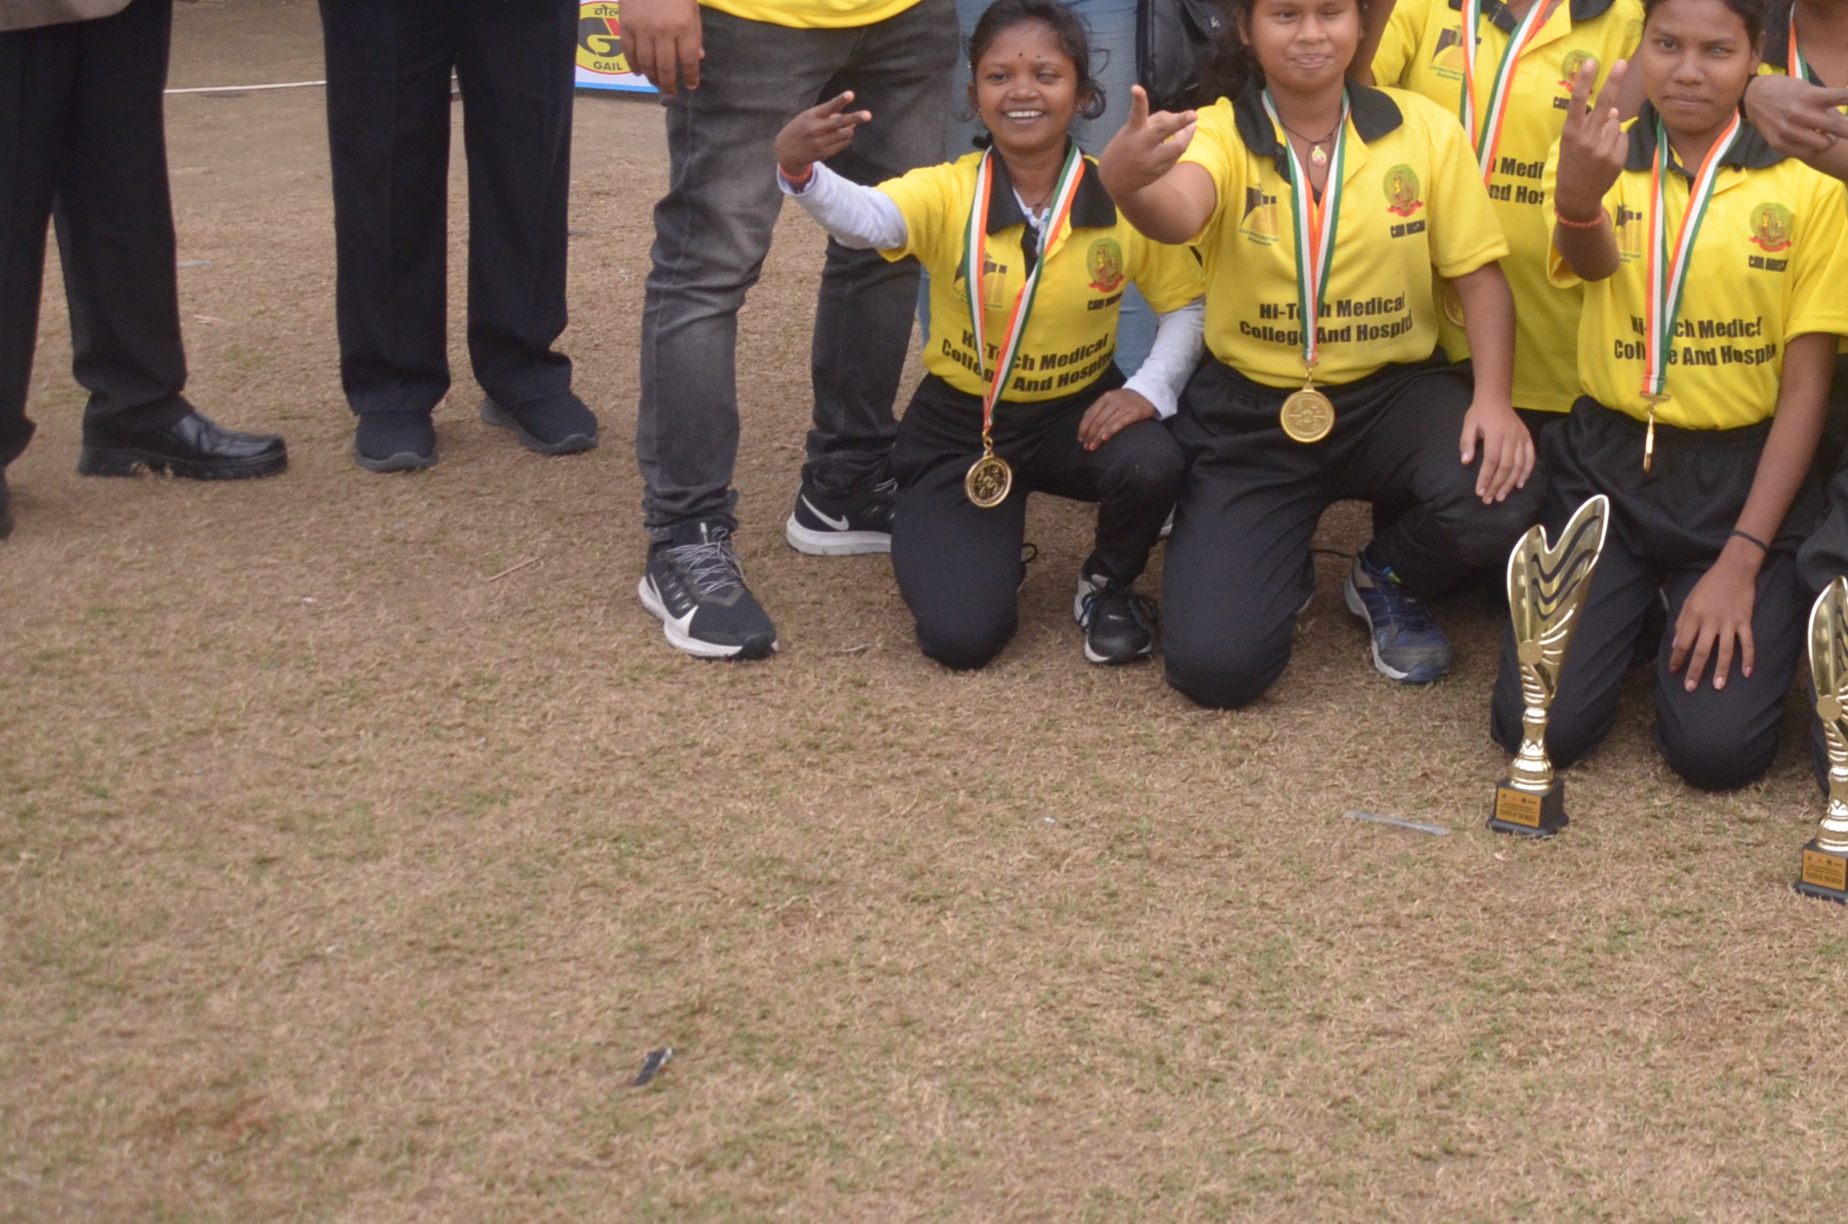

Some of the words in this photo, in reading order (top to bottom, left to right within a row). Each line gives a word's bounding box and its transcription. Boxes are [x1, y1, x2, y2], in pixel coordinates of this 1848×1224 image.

[593, 60, 623, 71] GAIL
[1316, 325, 1351, 344] And
[1040, 333, 1109, 371] Medical
[1683, 347, 1717, 366] And
[1012, 374, 1053, 392] And
